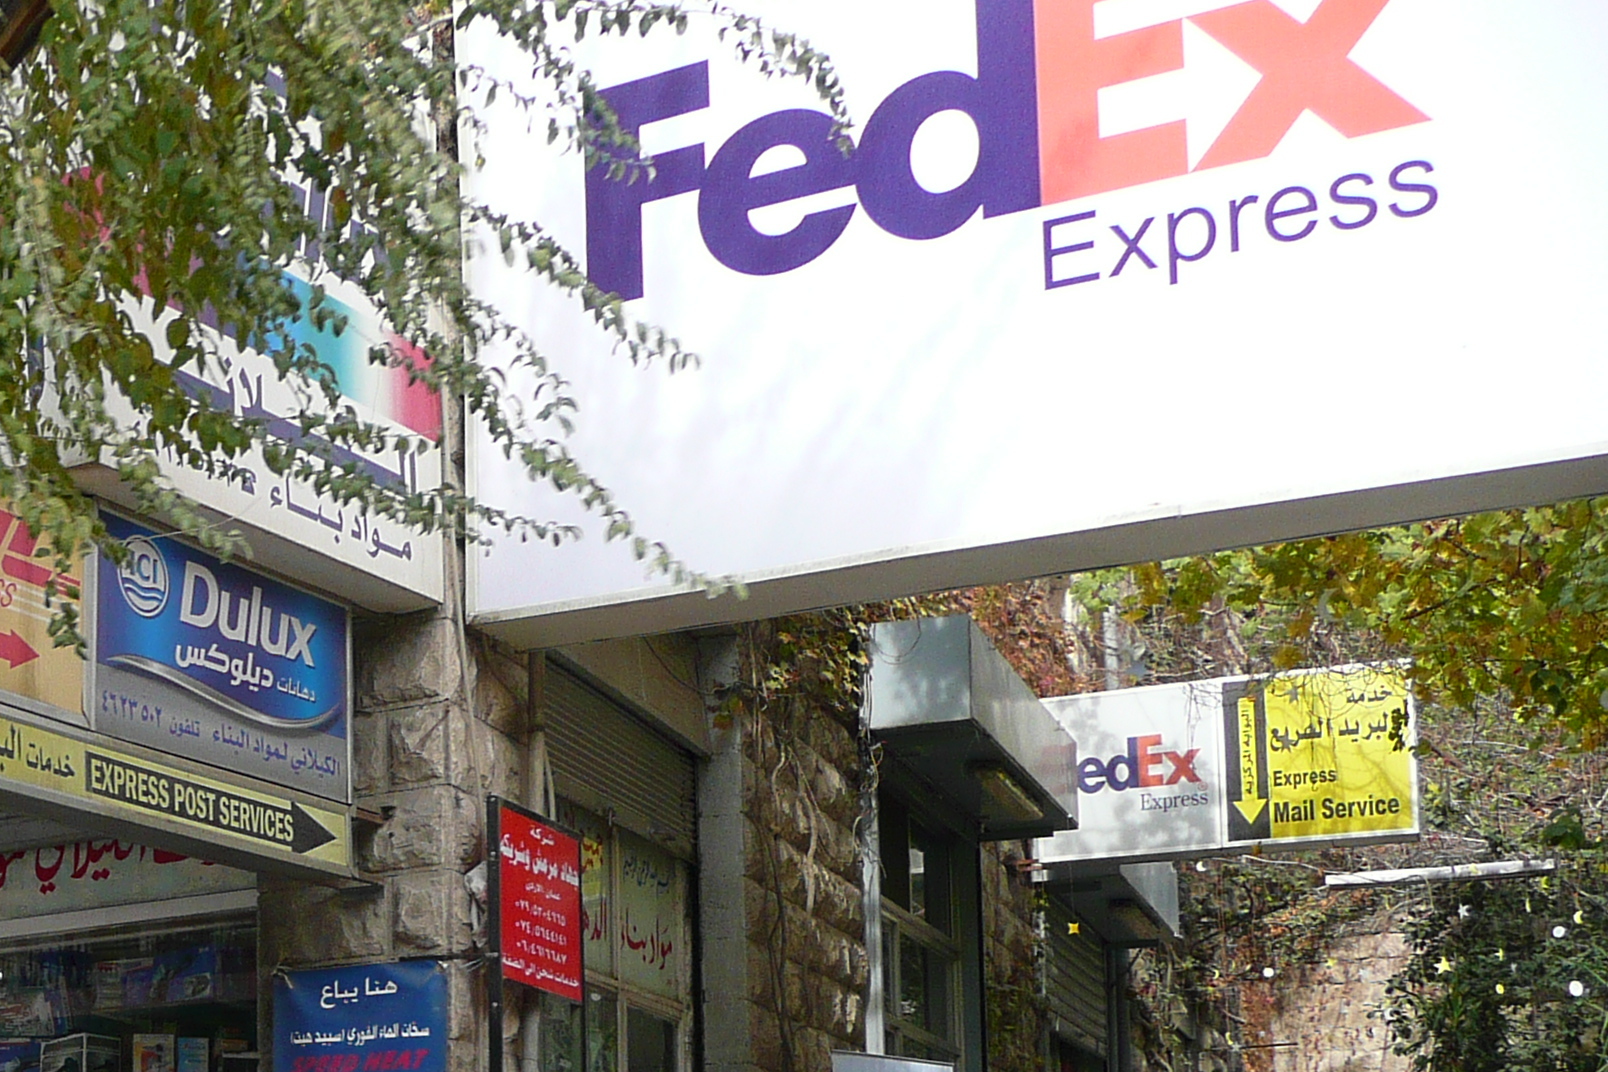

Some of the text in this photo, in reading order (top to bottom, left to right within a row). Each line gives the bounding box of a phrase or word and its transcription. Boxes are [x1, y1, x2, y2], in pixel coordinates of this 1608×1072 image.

[583, 0, 1433, 310] FedEx
[1039, 157, 1442, 291] Express
[350, 515, 412, 561] مواد
[180, 560, 317, 668] Dulux
[175, 643, 317, 703] دهانات ديلوكس
[26, 742, 76, 779] خدمات
[1077, 733, 1202, 794] edEx
[1273, 768, 1337, 790] Express
[90, 757, 295, 843] EXPRESS POST SERVICES
[1140, 792, 1209, 813] Express
[1273, 794, 1401, 824] Mail Service
[320, 976, 398, 1009] هنا يباع
[362, 1048, 431, 1072] HEAT
